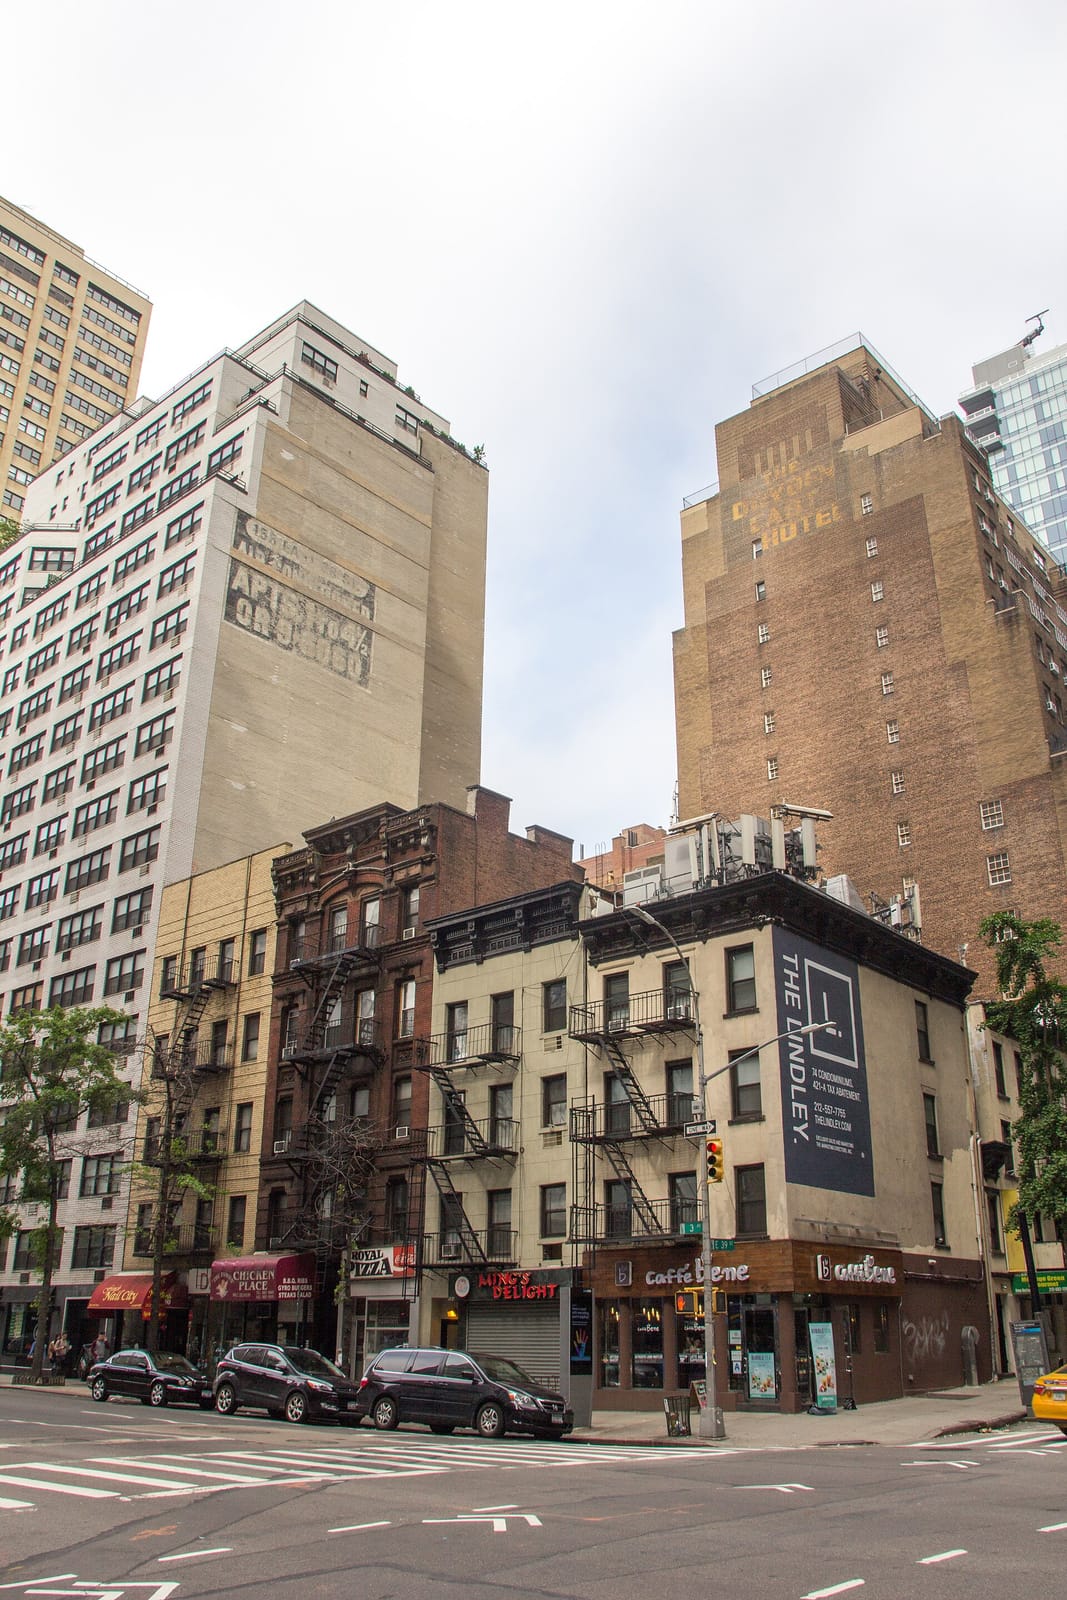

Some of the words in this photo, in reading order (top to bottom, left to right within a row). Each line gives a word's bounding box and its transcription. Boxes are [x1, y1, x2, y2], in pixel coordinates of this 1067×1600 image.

[782, 953, 802, 1010] THE
[826, 1083, 836, 1095] TAX
[689, 1223, 695, 1233] 3
[714, 1240, 719, 1249] E
[720, 1240, 728, 1249] 39
[352, 1249, 384, 1261] ROYAL
[232, 1270, 275, 1281] CHICKEN
[478, 1272, 531, 1288] MING'S
[238, 1281, 268, 1291] PLACE
[277, 1284, 291, 1292] GYRO
[492, 1284, 558, 1299] DELIGHT
[103, 1289, 121, 1302] Nail
[121, 1289, 139, 1305] City
